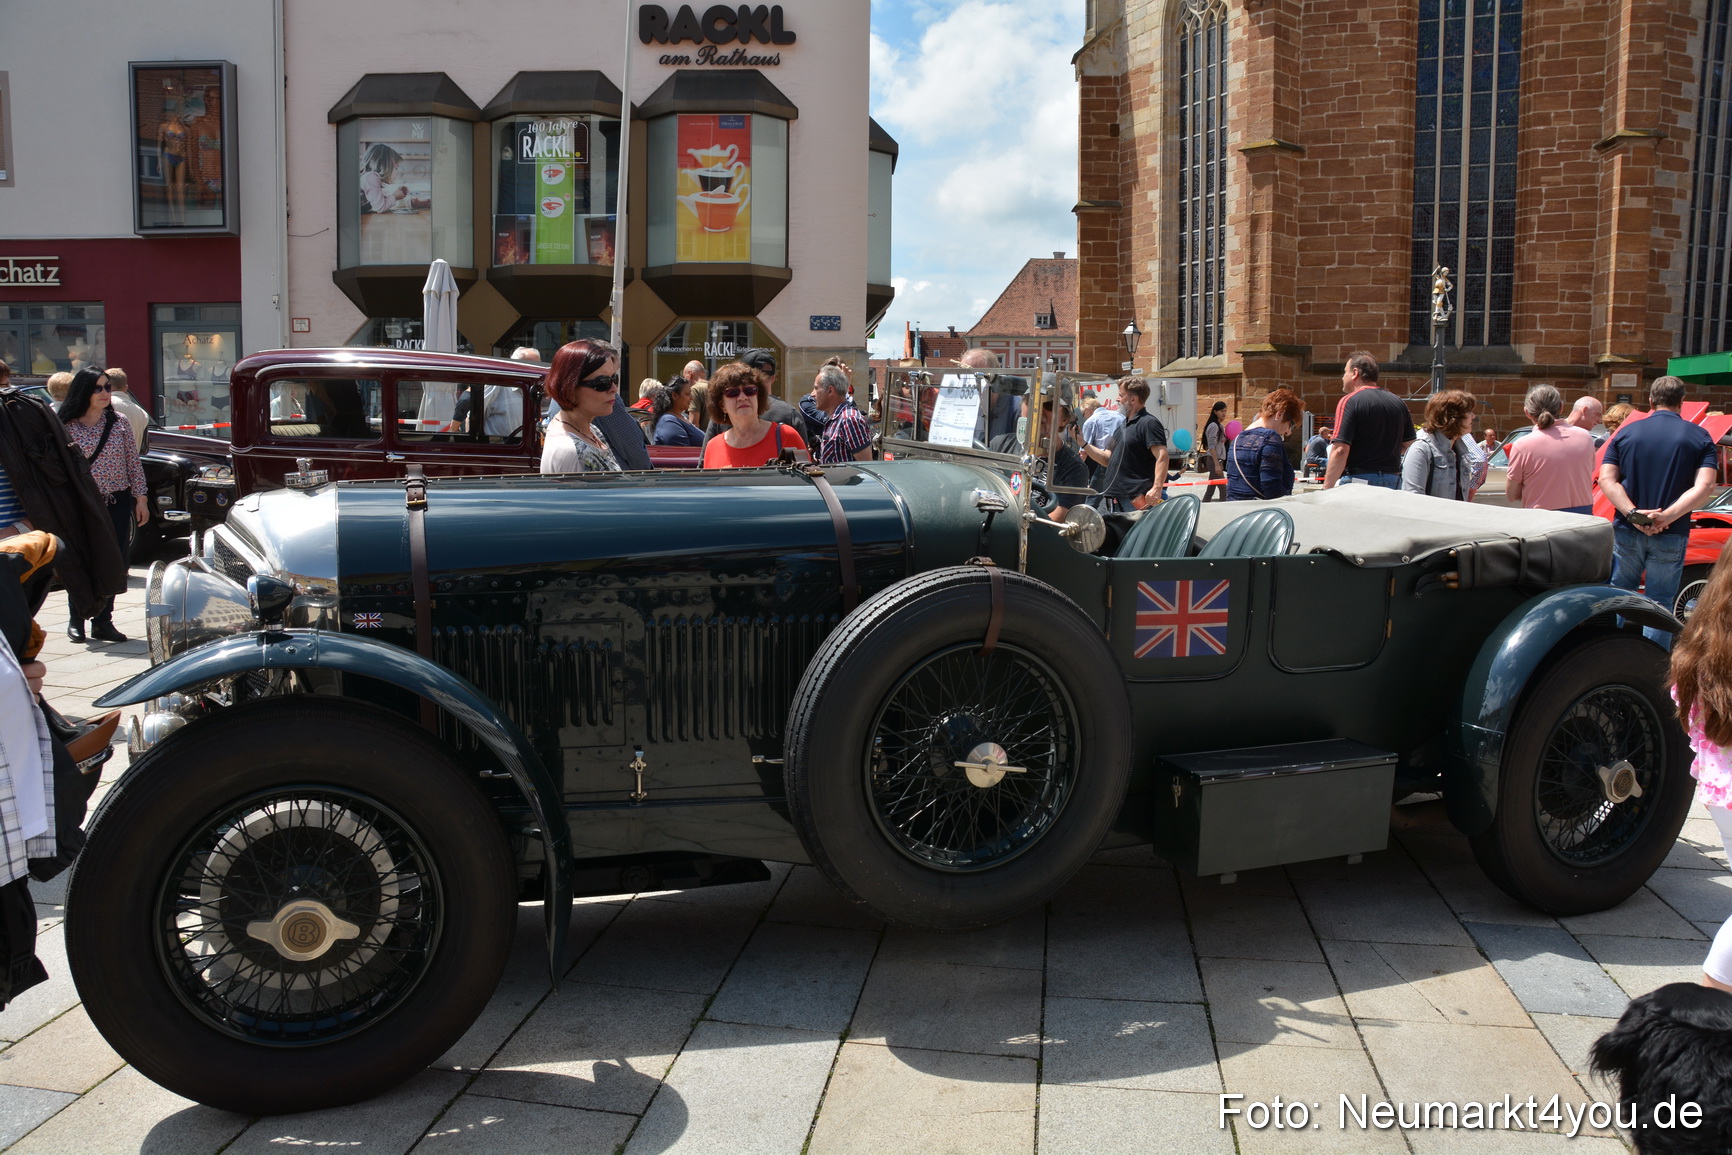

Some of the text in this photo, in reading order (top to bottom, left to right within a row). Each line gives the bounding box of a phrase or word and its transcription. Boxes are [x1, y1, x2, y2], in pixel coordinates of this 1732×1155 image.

[639, 4, 797, 45] RACKL
[658, 45, 781, 67] am Rathaus
[527, 120, 579, 134] 100 Jahre
[182, 334, 214, 345] Achatz
[396, 339, 425, 350] RACK
[704, 341, 736, 357] RACKL
[292, 921, 316, 945] B
